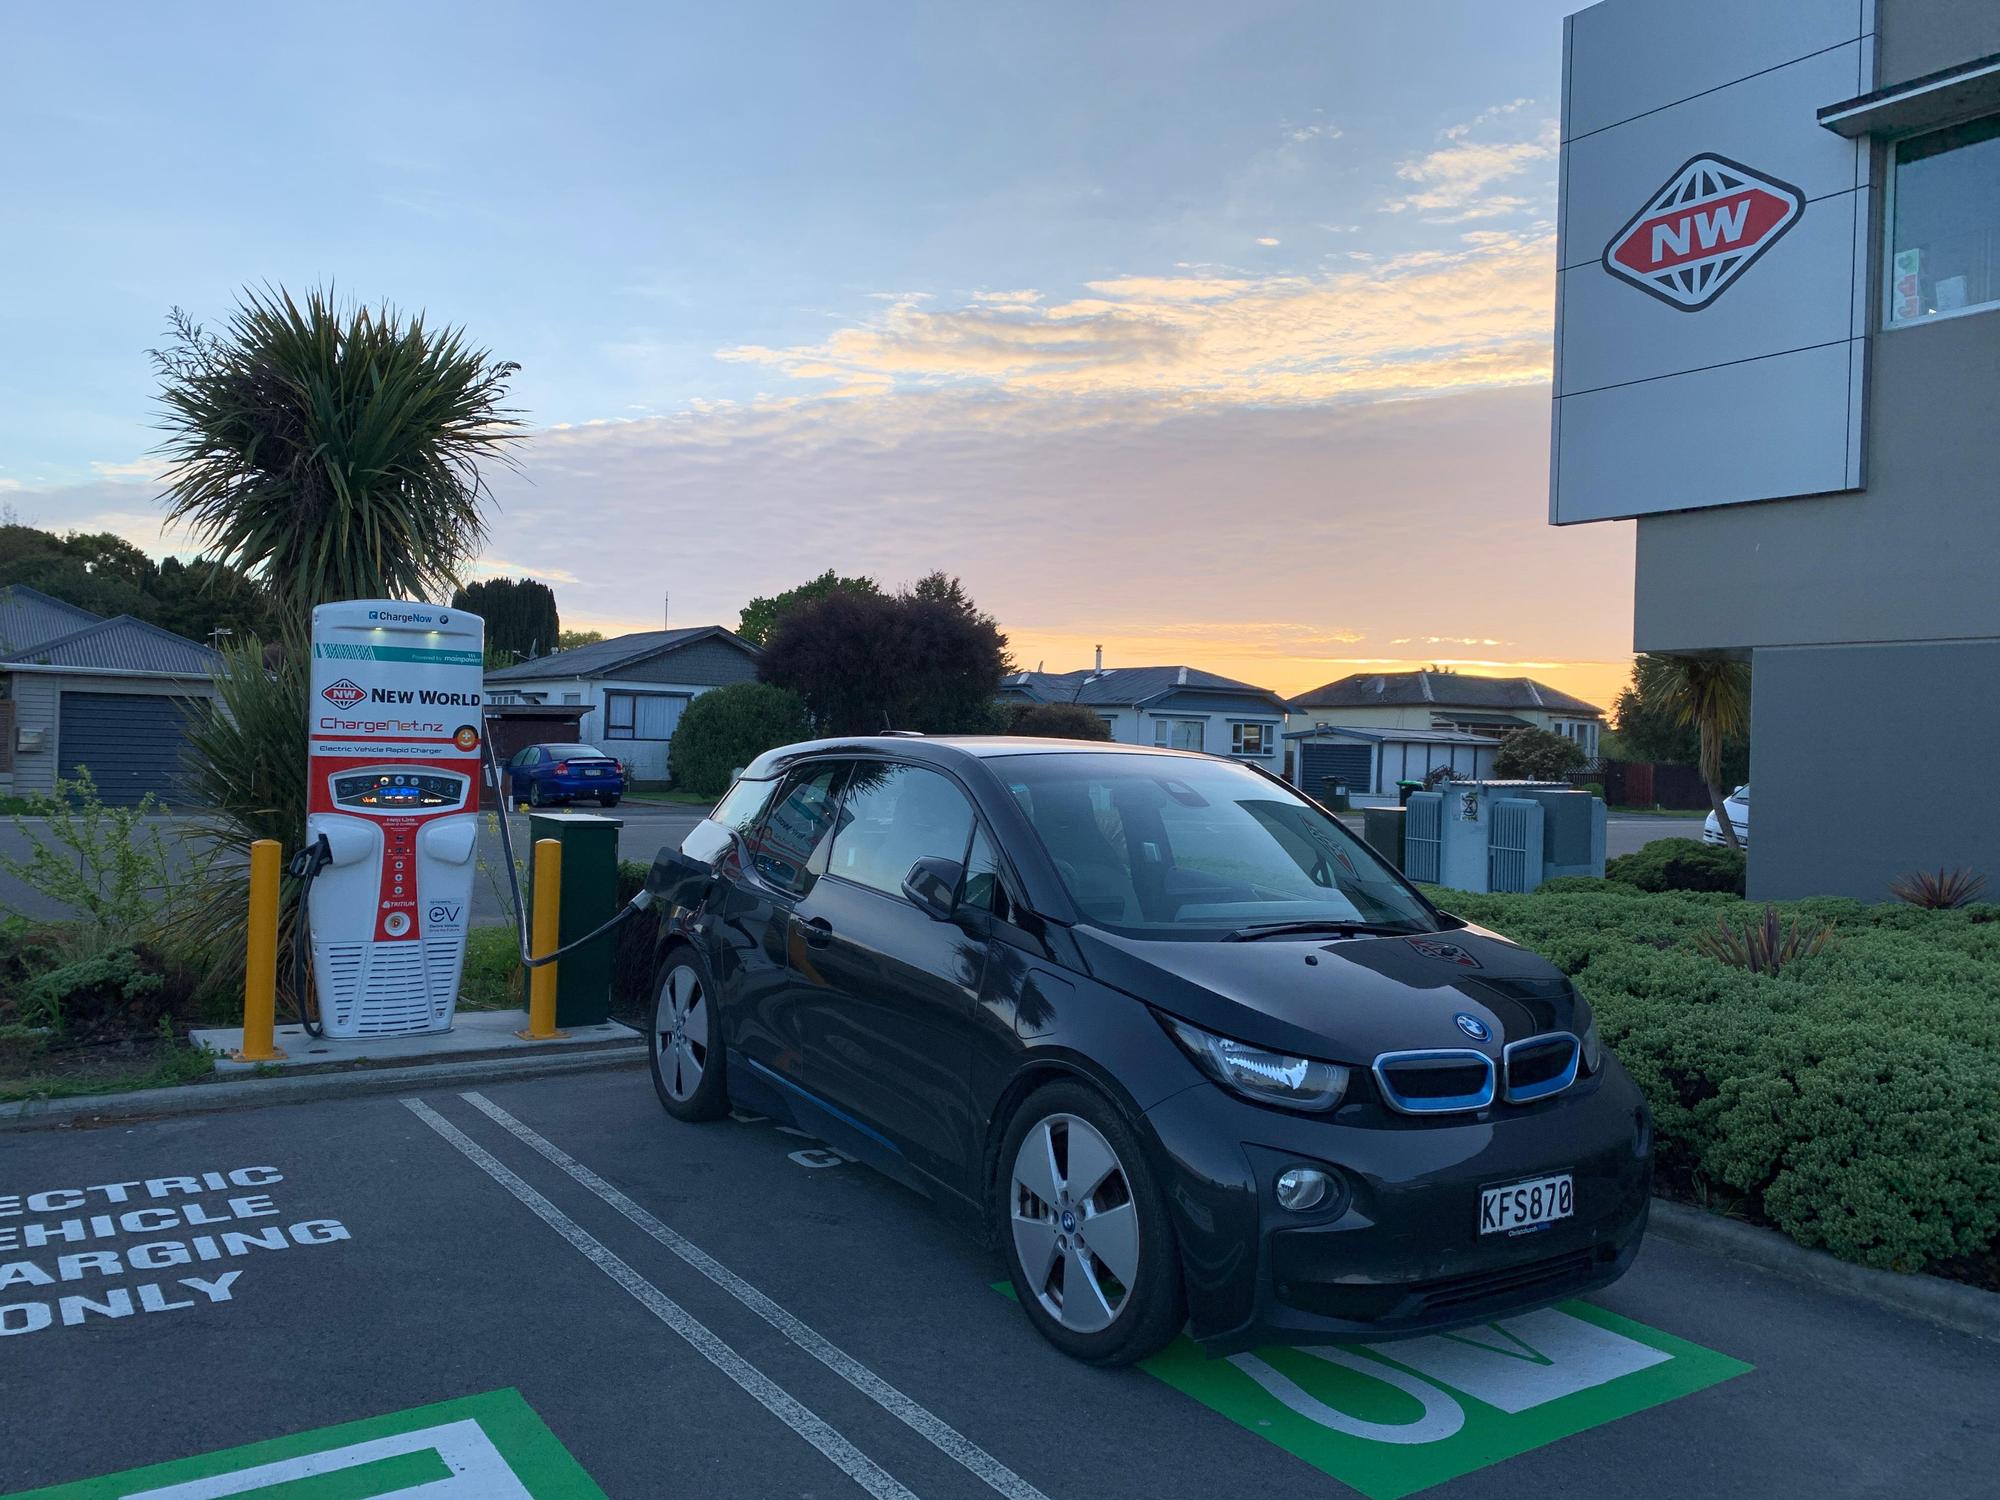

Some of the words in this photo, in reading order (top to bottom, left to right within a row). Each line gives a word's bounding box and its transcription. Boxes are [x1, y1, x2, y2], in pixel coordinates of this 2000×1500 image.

[1650, 199, 1752, 264] NW
[379, 611, 433, 623] ChargeNow
[444, 655, 481, 664] mainpower
[332, 690, 357, 699] NW
[371, 688, 414, 704] NEW
[419, 690, 480, 707] WORLD
[320, 717, 444, 733] ChargeNet.nz
[410, 747, 442, 755] Charger
[1482, 1180, 1571, 1230] KFS870
[0, 1270, 243, 1336] ONLY
